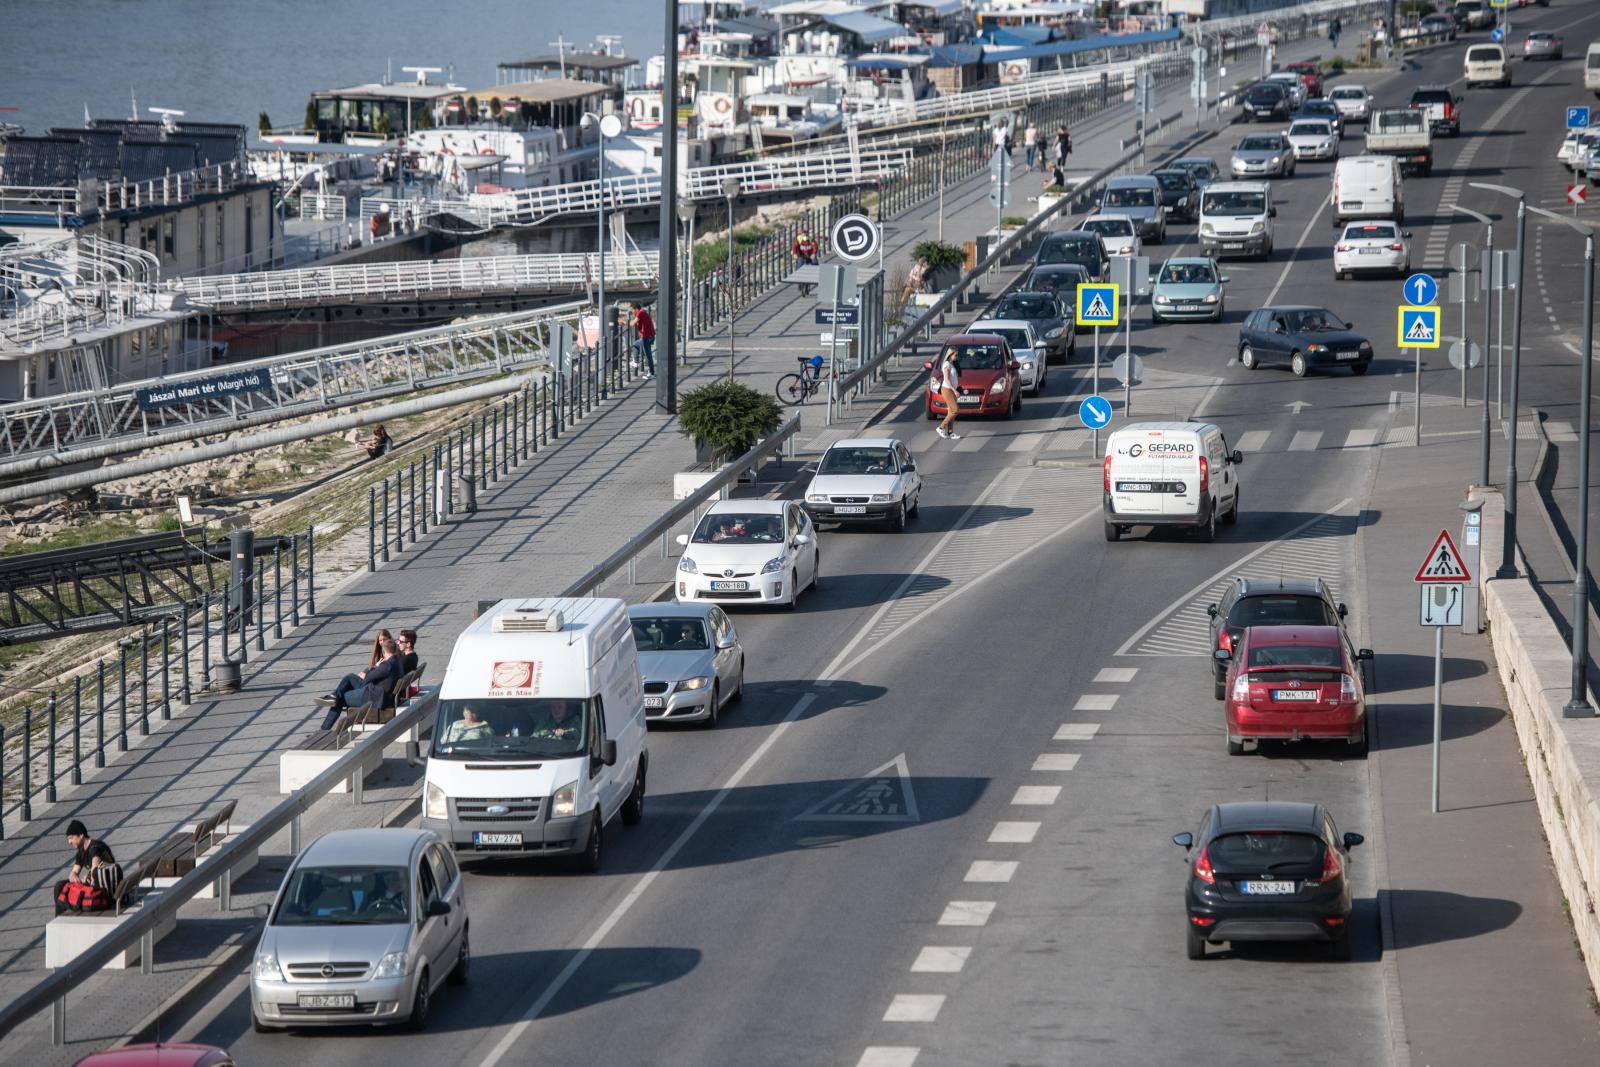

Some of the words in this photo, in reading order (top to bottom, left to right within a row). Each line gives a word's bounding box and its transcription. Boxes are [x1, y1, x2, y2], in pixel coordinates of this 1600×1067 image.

[1570, 109, 1577, 119] P
[148, 391, 176, 403] Jászai
[178, 386, 200, 398] Mari
[202, 383, 216, 393] tér
[217, 379, 244, 392] (Margit
[245, 375, 260, 386] híd)
[1148, 443, 1194, 452] GEPARD
[1279, 691, 1315, 699] PMK-171
[481, 834, 520, 843] LRV-274
[1249, 882, 1293, 892] RRK-241
[309, 995, 352, 1007] JBZ-912
